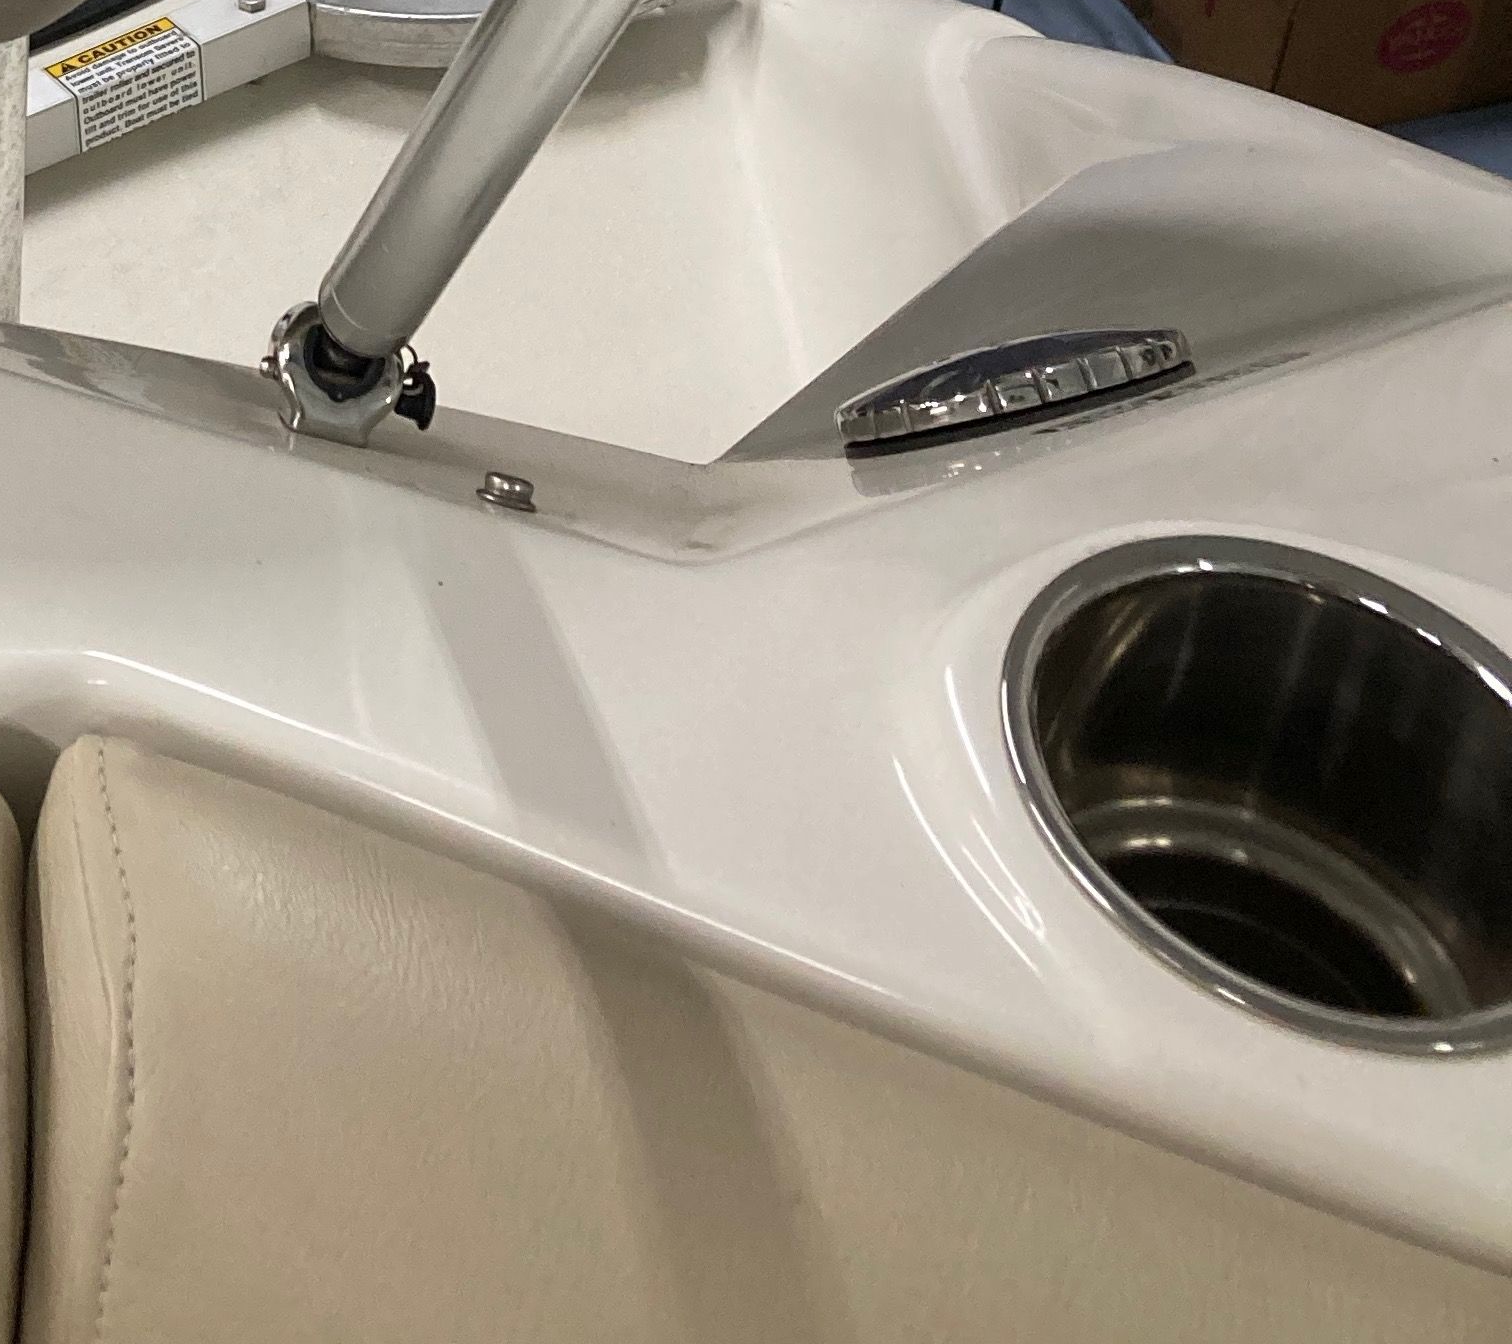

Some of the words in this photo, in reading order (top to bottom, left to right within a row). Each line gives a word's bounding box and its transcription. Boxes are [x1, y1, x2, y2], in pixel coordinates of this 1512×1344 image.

[65, 68, 91, 81] Avoid
[92, 52, 127, 69] damage
[139, 30, 178, 50] outboard
[78, 24, 163, 64] CAUTION
[70, 74, 94, 87] lower
[116, 50, 154, 67] Transom
[78, 80, 101, 93] must
[102, 75, 114, 83] be
[116, 58, 155, 79] properly
[155, 47, 180, 60] fitted
[82, 88, 108, 105] trailer
[110, 78, 134, 92] roller
[134, 69, 150, 82] and
[151, 53, 185, 74] secured
[136, 73, 167, 91] lower
[84, 102, 124, 125] Outboard
[125, 92, 148, 107] must
[148, 83, 169, 97] have
[170, 70, 197, 89] power
[99, 115, 116, 129] and
[117, 108, 136, 121] trim
[137, 101, 151, 111] for
[152, 94, 169, 105] use
[169, 87, 180, 97] of
[181, 81, 198, 92] this
[124, 114, 145, 128] Boat
[146, 103, 168, 119] must
[169, 99, 180, 109] be
